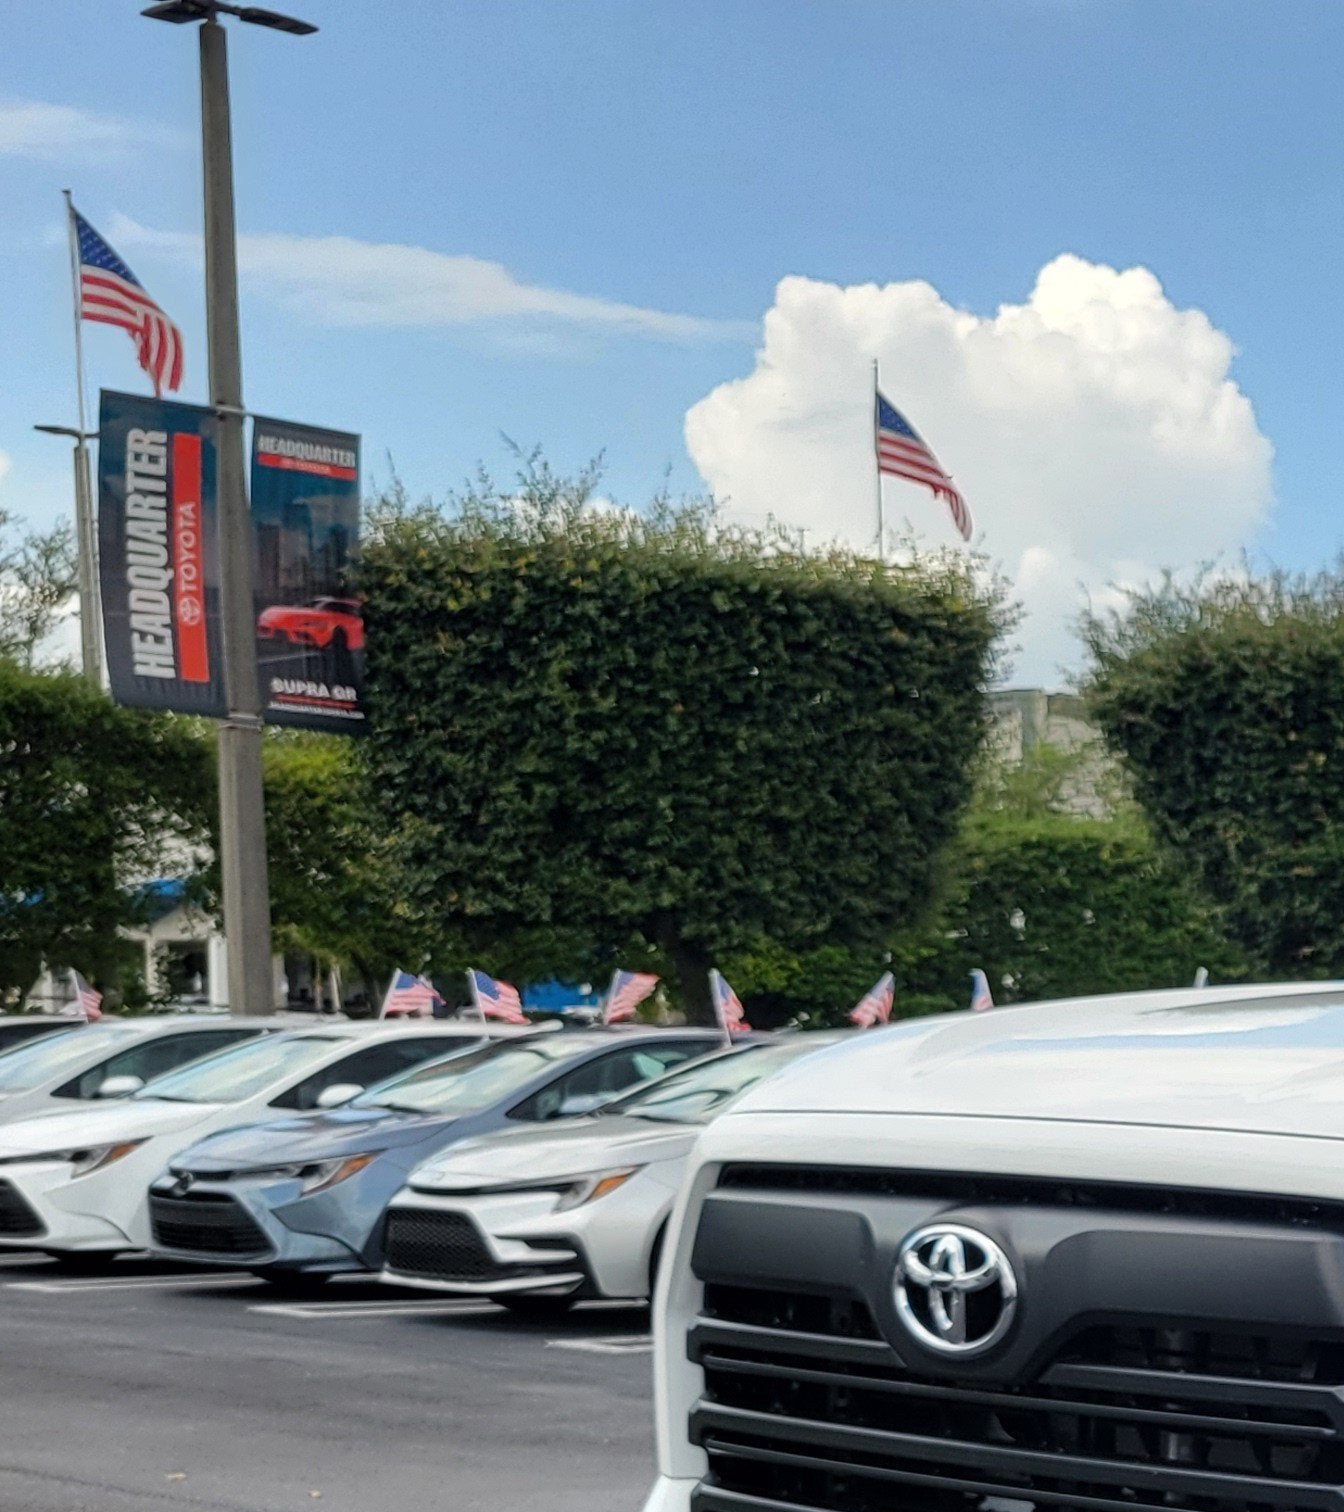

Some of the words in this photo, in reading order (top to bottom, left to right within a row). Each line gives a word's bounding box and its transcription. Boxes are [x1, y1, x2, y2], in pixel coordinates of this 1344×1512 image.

[258, 435, 356, 468] HEADQUARTER
[126, 427, 176, 679] HEADQUARTER
[177, 501, 197, 592] TOYOTA
[270, 677, 331, 698] SUPRA
[331, 684, 358, 702] GR
